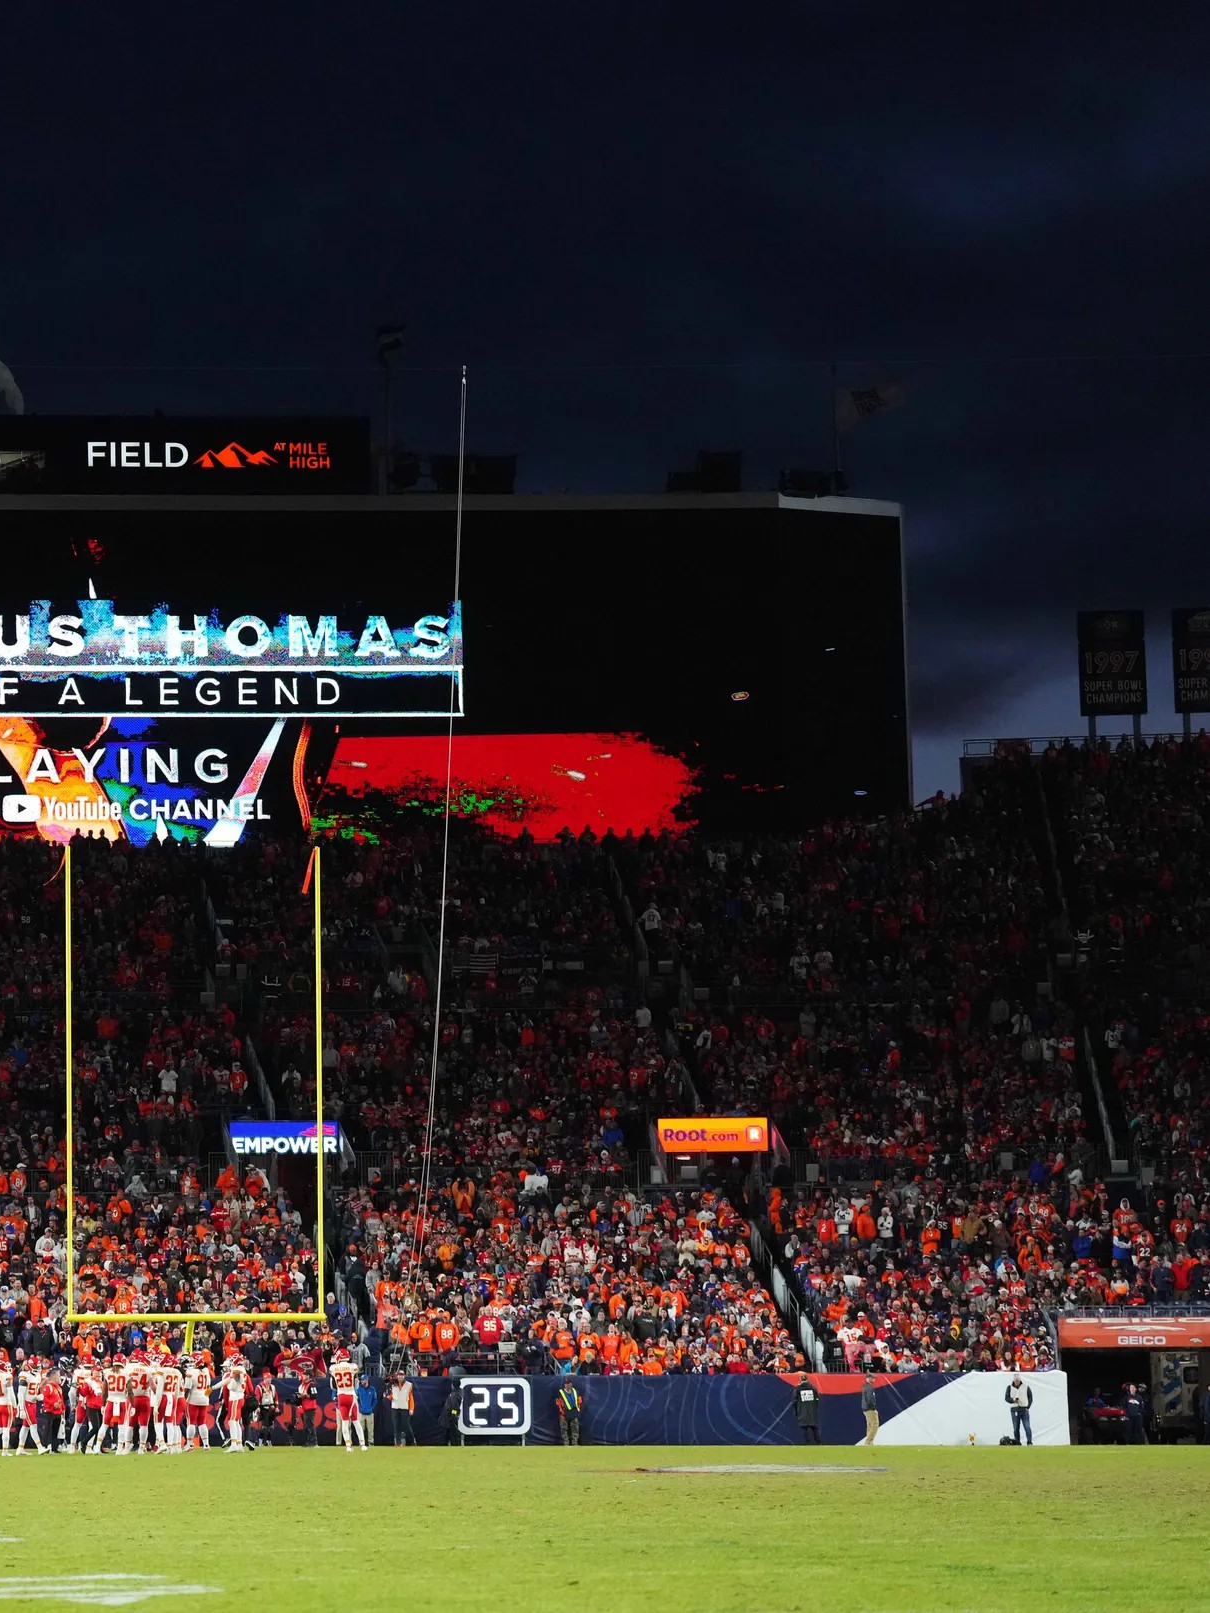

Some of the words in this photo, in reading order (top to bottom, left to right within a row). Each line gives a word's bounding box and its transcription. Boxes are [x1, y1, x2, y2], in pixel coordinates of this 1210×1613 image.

[87, 441, 189, 468] FIELD
[274, 442, 287, 451] AT
[289, 442, 328, 455] MILE
[289, 456, 331, 469] HIGH
[113, 614, 451, 658] THOMAS
[1085, 651, 1139, 673] 1997
[1084, 680, 1113, 692] SUPER
[1118, 679, 1144, 691] BOWL
[1178, 677, 1208, 689] SUPER
[58, 677, 85, 705] A
[125, 677, 341, 705] LEGEND
[1086, 692, 1142, 704] CHAMPIONS
[45, 797, 122, 821] YouTube
[130, 798, 271, 821] CHANNEL
[663, 1128, 739, 1142] Root.com
[231, 1136, 338, 1154] EMPOWER
[1175, 1224, 1187, 1233] 24
[1139, 1248, 1150, 1257] 22
[483, 1320, 497, 1331] 95
[441, 1329, 453, 1339] 88
[846, 1332, 857, 1342] 15
[1117, 1336, 1167, 1345] GEICO
[107, 1374, 126, 1392] 20
[130, 1373, 148, 1391] 54
[197, 1374, 208, 1391] 91
[334, 1371, 353, 1389] 23
[468, 1388, 519, 1425] 25
